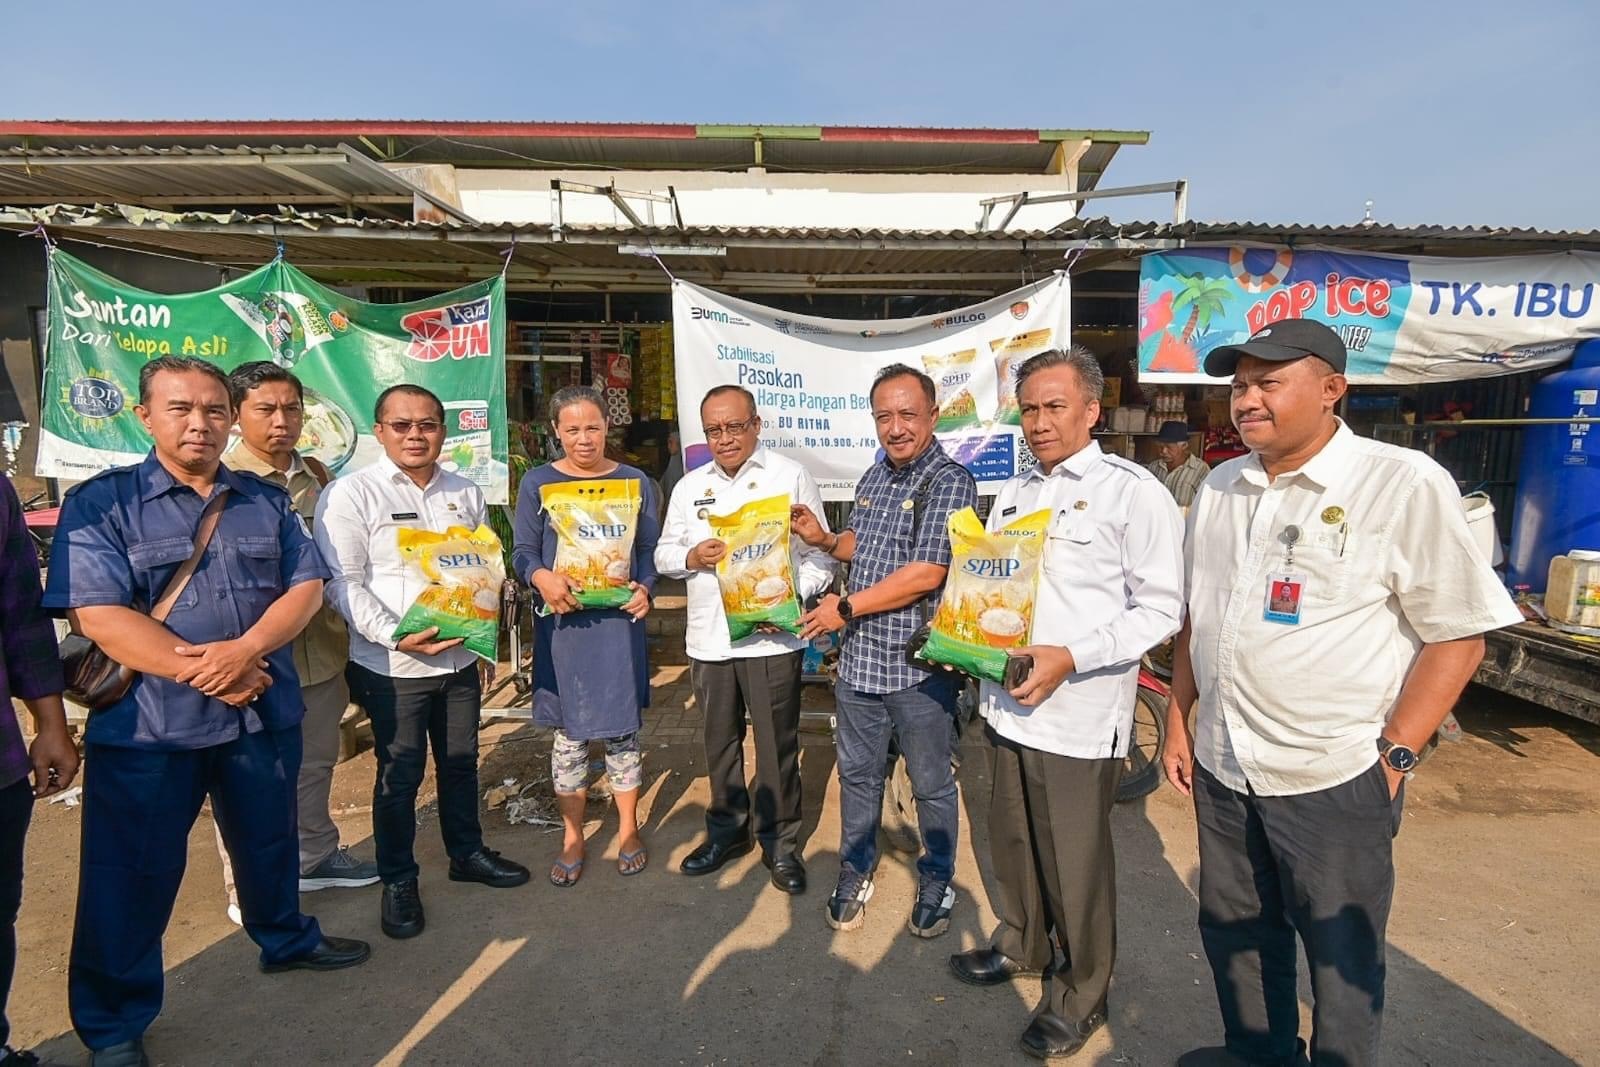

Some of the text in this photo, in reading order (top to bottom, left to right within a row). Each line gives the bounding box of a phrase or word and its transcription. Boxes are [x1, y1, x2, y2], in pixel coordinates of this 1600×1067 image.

[1421, 281, 1594, 318] TK. IBU
[64, 291, 171, 328] Santan
[946, 313, 986, 325] BULOG
[62, 323, 112, 347] Dari
[182, 334, 227, 355] Asli
[401, 310, 491, 361] SUN
[717, 344, 775, 365] Stabilisasi
[738, 363, 803, 389] Pasokan
[74, 383, 118, 401] TOP
[758, 389, 796, 410] Harga
[800, 392, 846, 412] Pangan
[74, 397, 118, 410] BRAND
[778, 416, 792, 429] BU
[798, 418, 831, 430] RITHA
[779, 437, 797, 448] Jual
[578, 524, 627, 537] SPHP
[1003, 529, 1037, 538] BULOG
[963, 558, 1020, 577] SPHP
